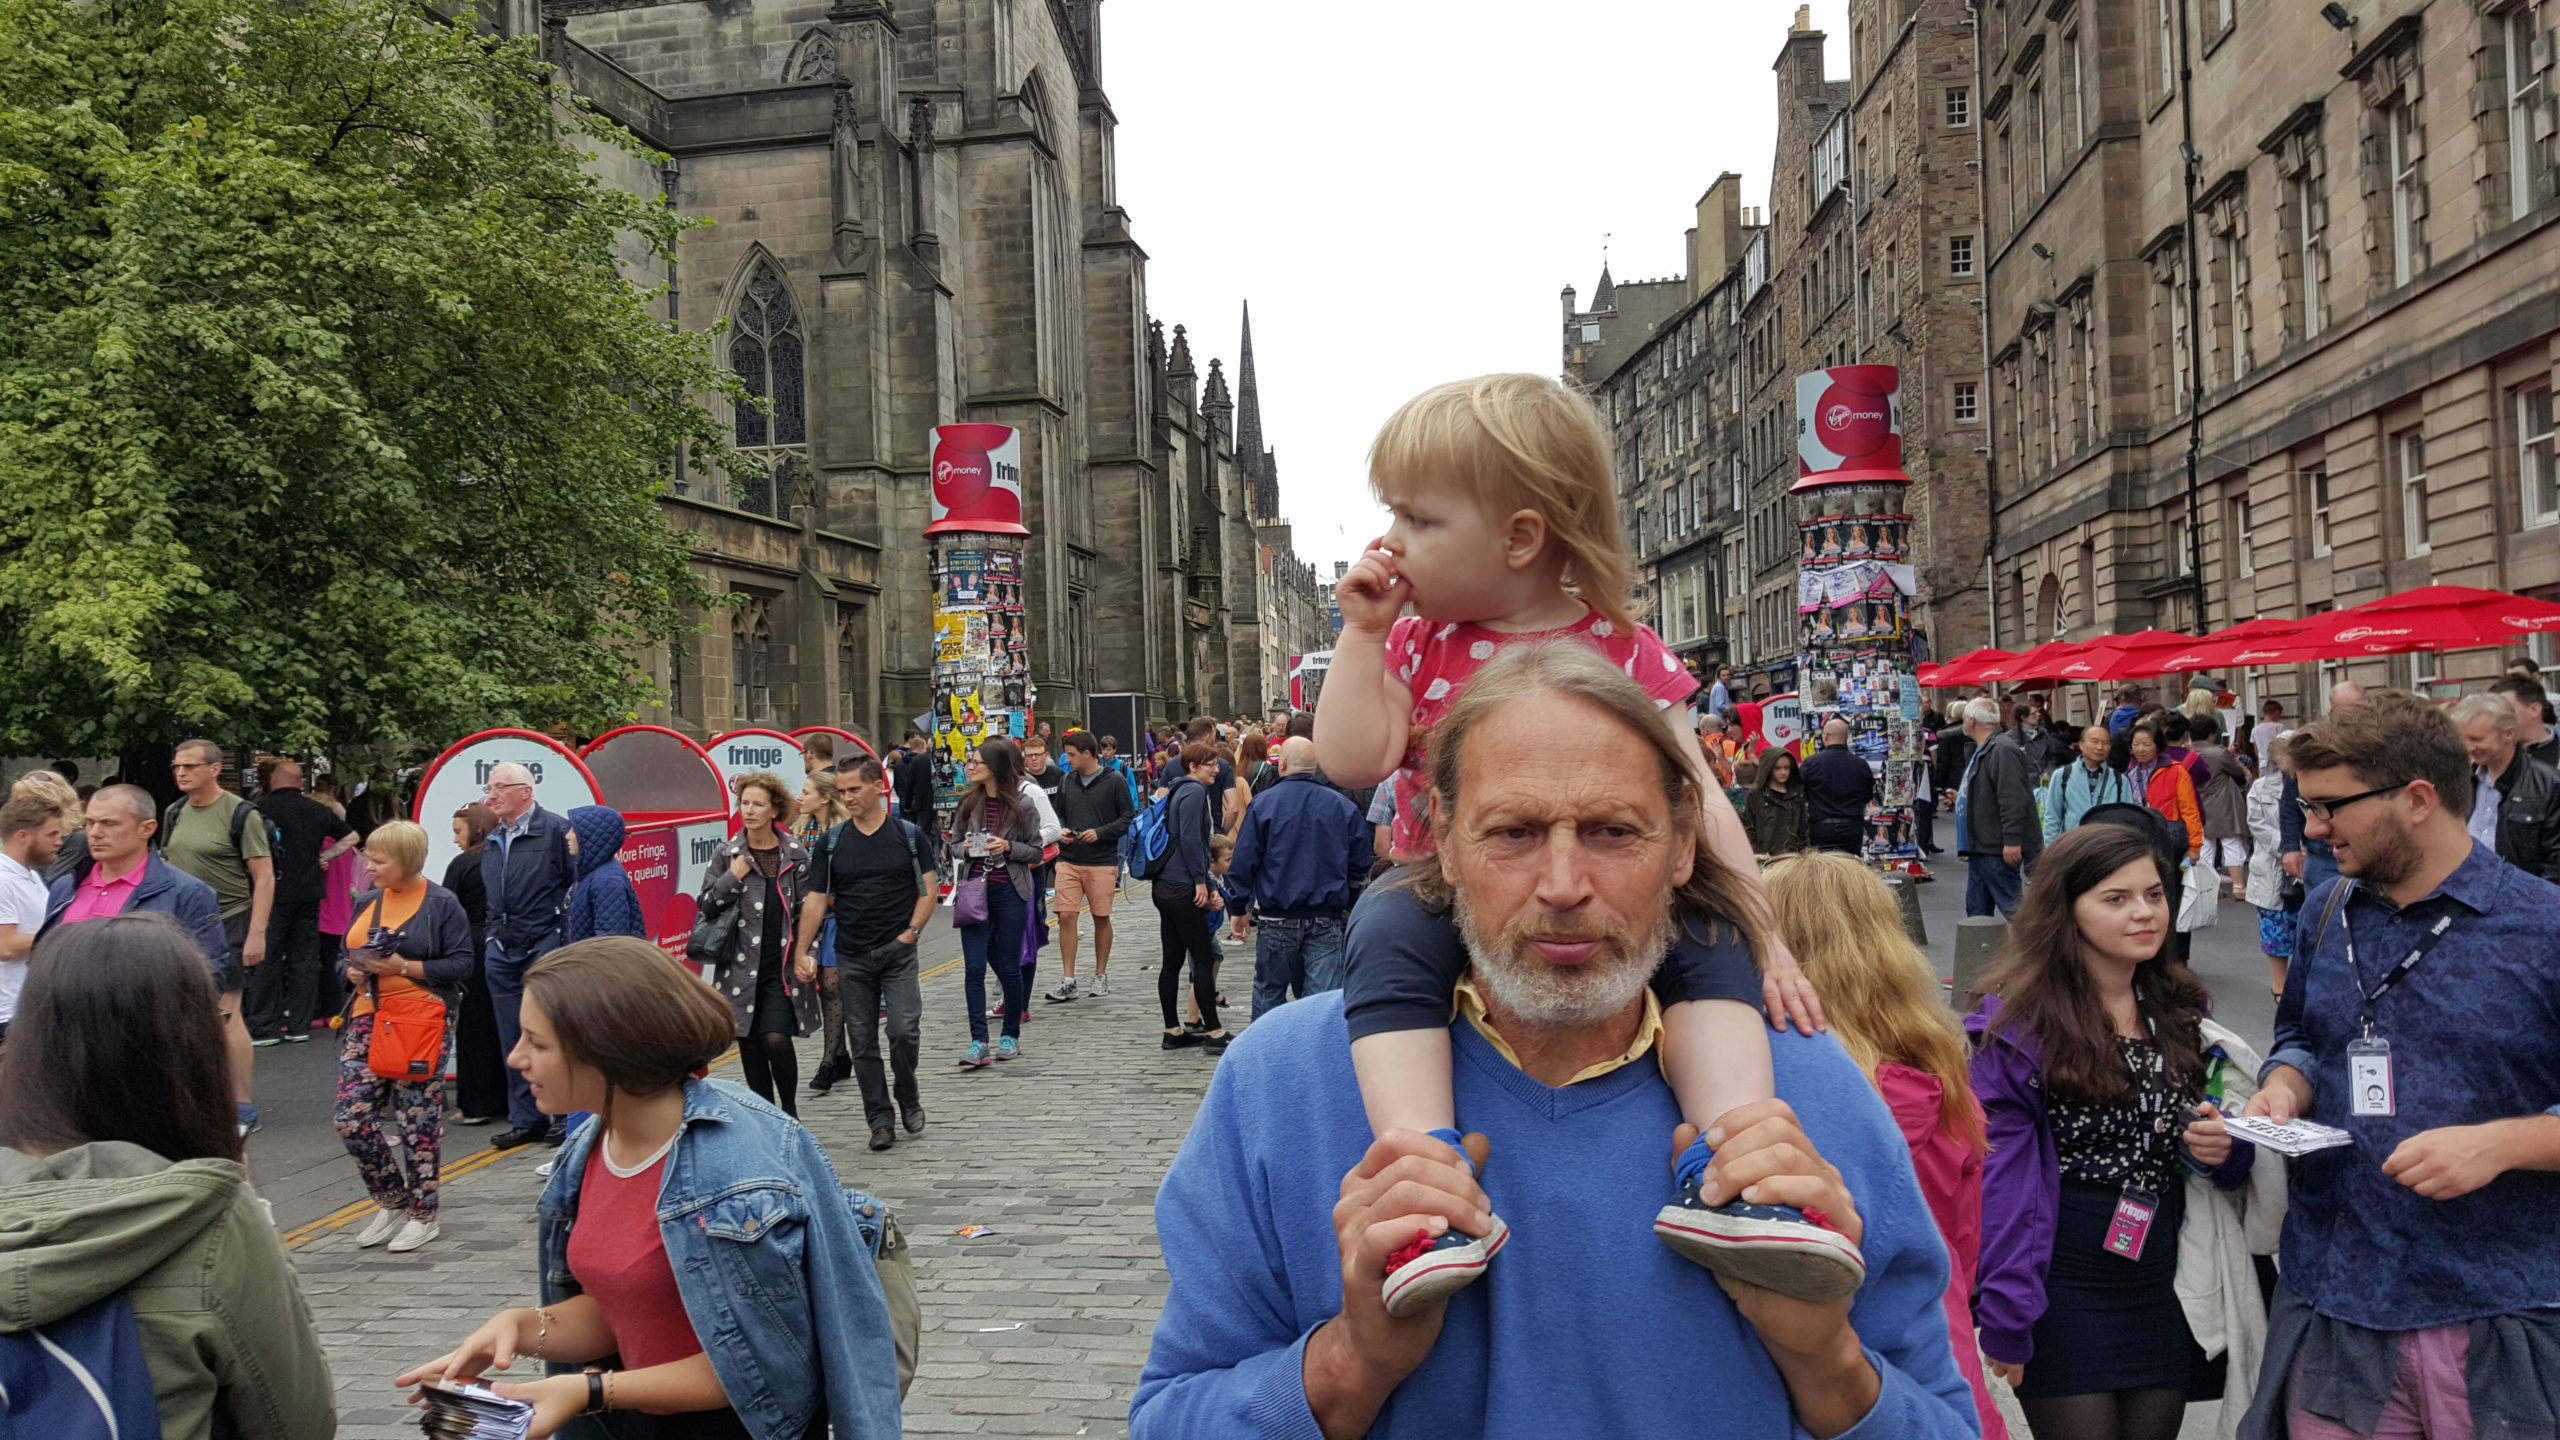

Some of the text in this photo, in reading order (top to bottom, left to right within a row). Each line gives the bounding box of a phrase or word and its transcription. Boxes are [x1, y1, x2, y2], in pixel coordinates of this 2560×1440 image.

[1853, 411, 1883, 421] money
[953, 466, 981, 476] money
[1825, 485, 1853, 497] DOLLS
[1857, 484, 1884, 493] DOLLS
[1312, 656, 1331, 666] fring
[1812, 671, 1836, 680] DOLLS
[955, 686, 972, 695] LOVE
[961, 725, 978, 733] LOVE
[728, 745, 782, 769] fringe
[639, 843, 667, 860] Fringe,
[634, 862, 668, 884] queuing
[2119, 1201, 2150, 1221] fringe
